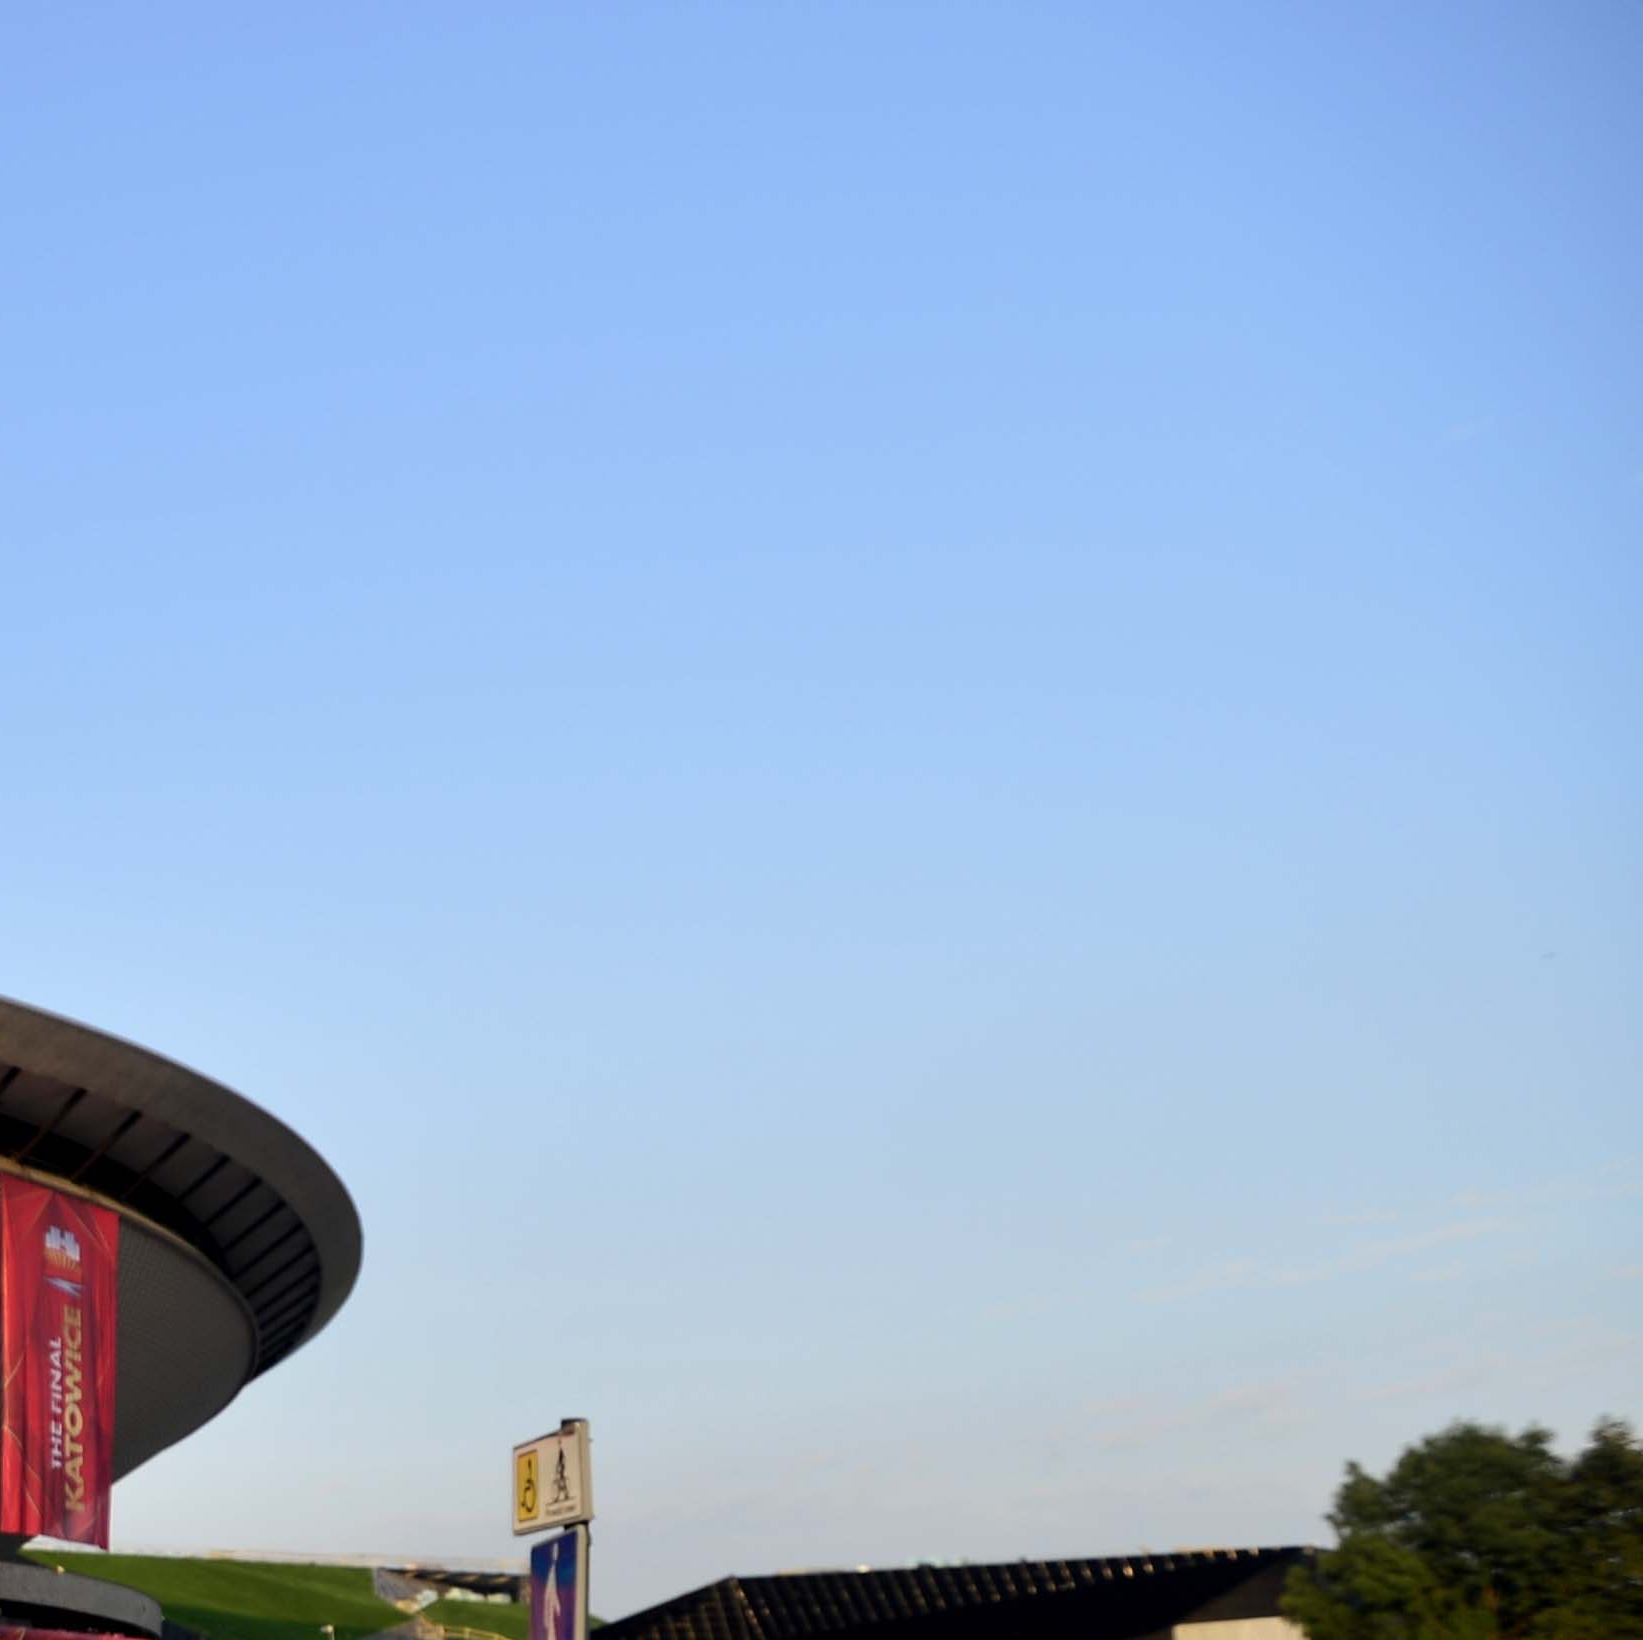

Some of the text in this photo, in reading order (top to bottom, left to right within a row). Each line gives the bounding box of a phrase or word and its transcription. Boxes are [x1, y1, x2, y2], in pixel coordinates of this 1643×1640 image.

[49, 1336, 63, 1468] THE FINAL
[63, 1304, 85, 1511] KATOWICE
